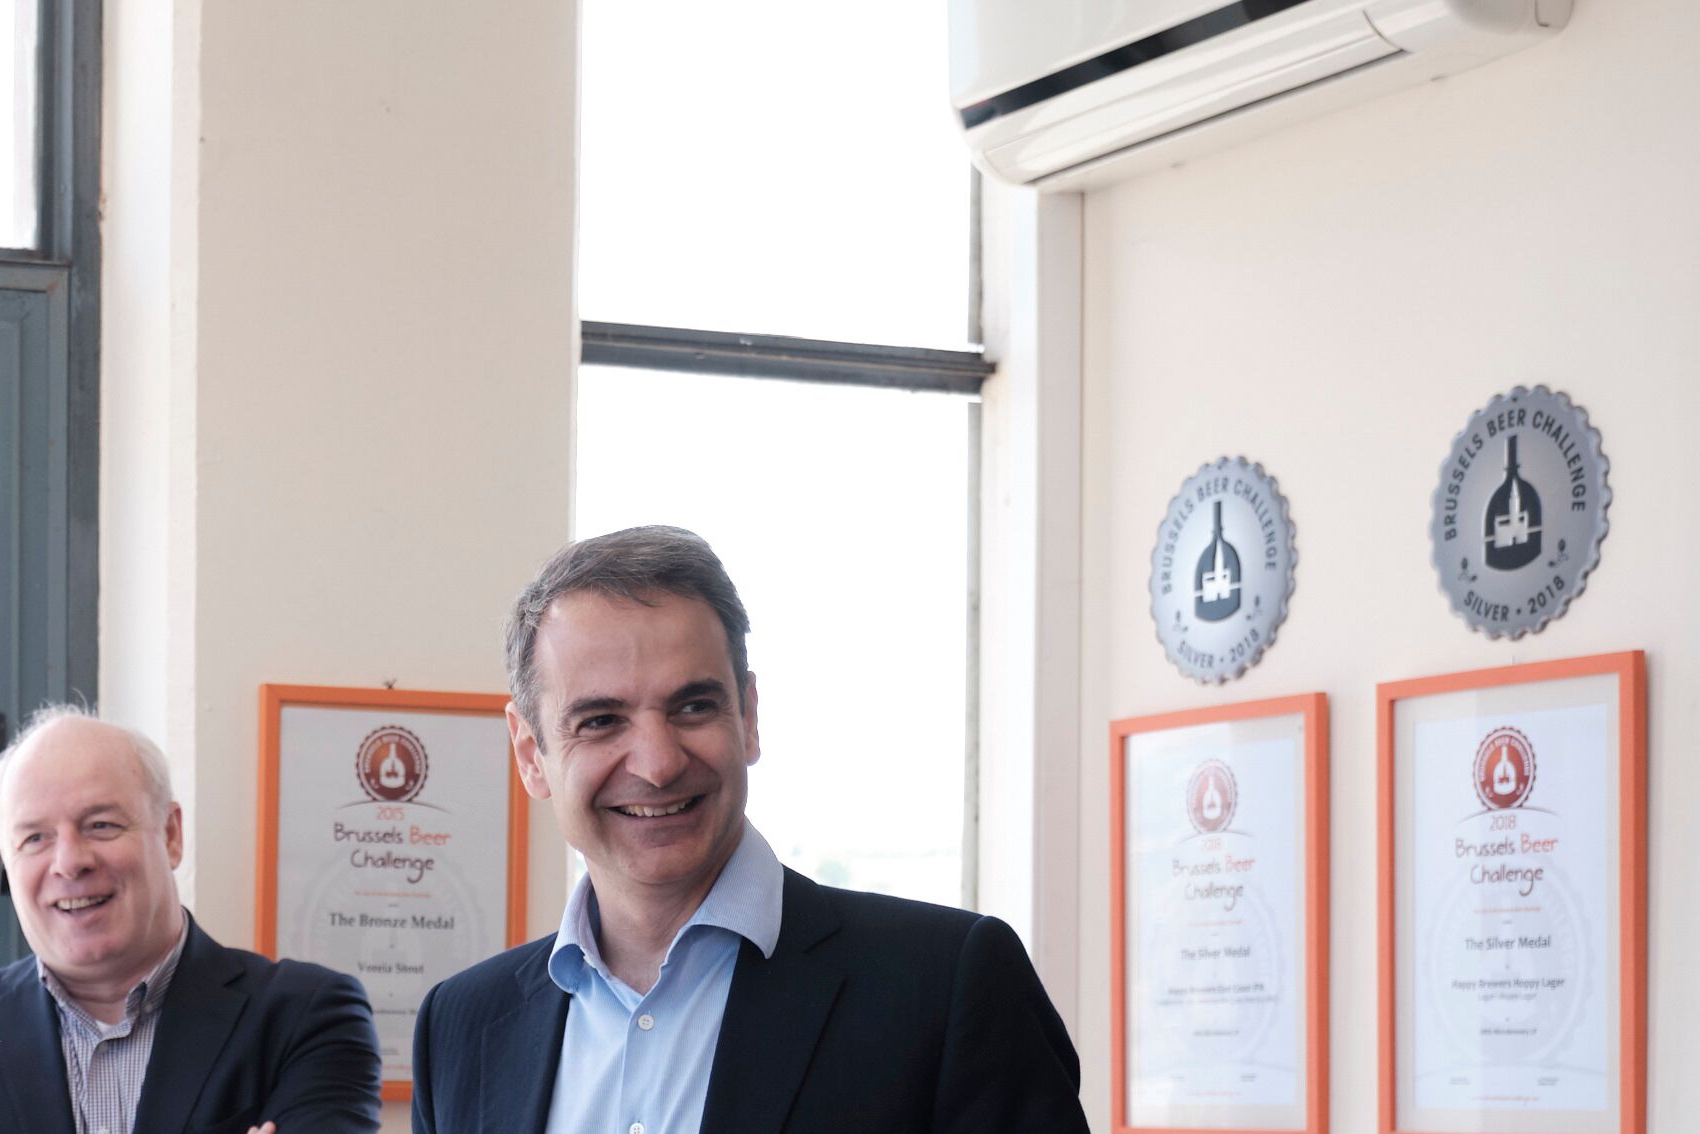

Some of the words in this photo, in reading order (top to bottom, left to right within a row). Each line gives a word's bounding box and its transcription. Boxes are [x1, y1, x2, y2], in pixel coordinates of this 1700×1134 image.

[1444, 434, 1483, 541] BRUSSELS
[1486, 408, 1527, 437] BEER
[1532, 411, 1586, 512] CHALLENGE
[1162, 498, 1195, 595] BRUSSELS
[1197, 477, 1229, 499] BEER
[1233, 479, 1278, 571] CHALLENGE
[1464, 590, 1508, 621] SILVER
[1527, 575, 1565, 615] 2018
[1177, 640, 1214, 668] SILVER
[1229, 629, 1260, 663] 2018
[333, 822, 403, 844] Brussels
[410, 825, 452, 845] Beer
[1490, 815, 1516, 831] 2018
[1455, 837, 1515, 858] Brussels
[1520, 833, 1559, 853] Beer
[350, 849, 435, 884] Challenge
[1172, 858, 1221, 877] Brussels
[1225, 854, 1256, 872] Beer
[1470, 864, 1544, 897] Challenge
[1185, 882, 1244, 912] Challenge
[330, 913, 356, 927] The
[359, 914, 407, 929] Bronze
[411, 916, 455, 930] Medal
[1465, 938, 1484, 950] The
[1486, 936, 1515, 950] Silver
[1518, 935, 1551, 949] Medal
